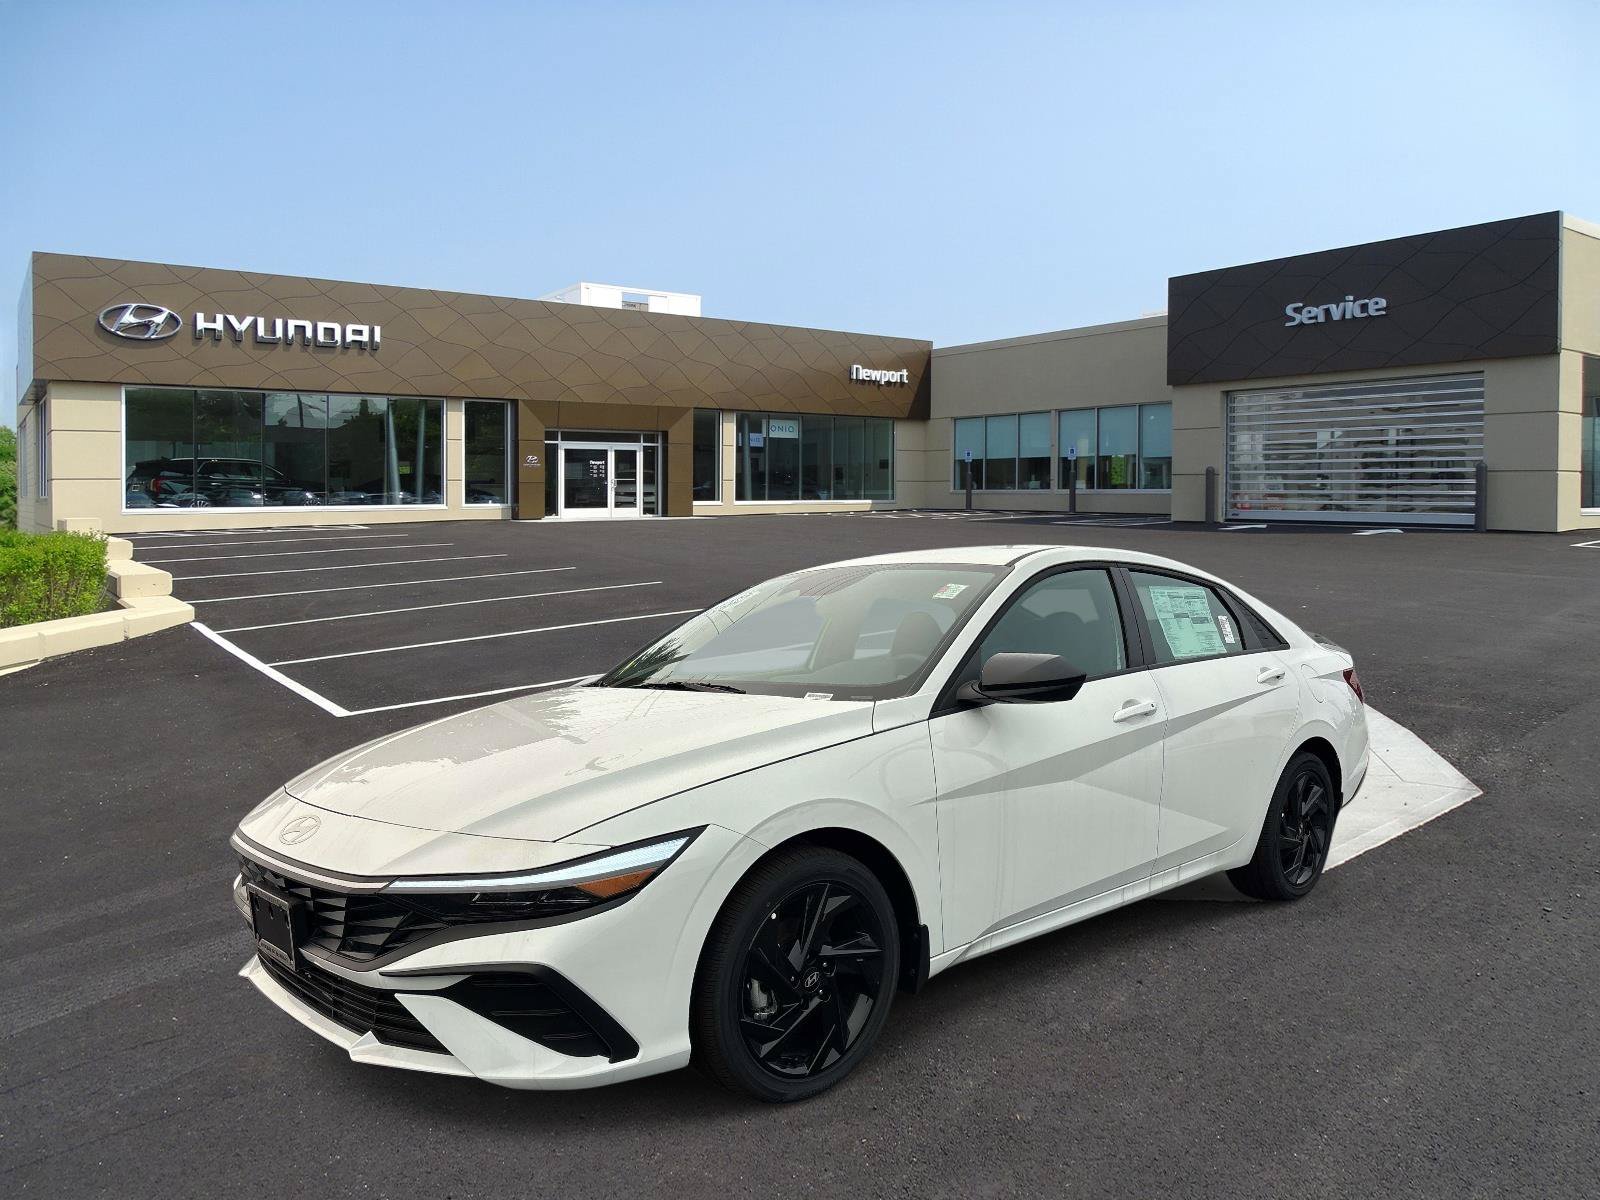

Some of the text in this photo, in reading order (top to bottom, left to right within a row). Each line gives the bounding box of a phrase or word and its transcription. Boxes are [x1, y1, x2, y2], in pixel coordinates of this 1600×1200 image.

[1284, 295, 1387, 327] Service
[194, 312, 381, 351] HYUNDAI
[850, 364, 909, 385] Newport
